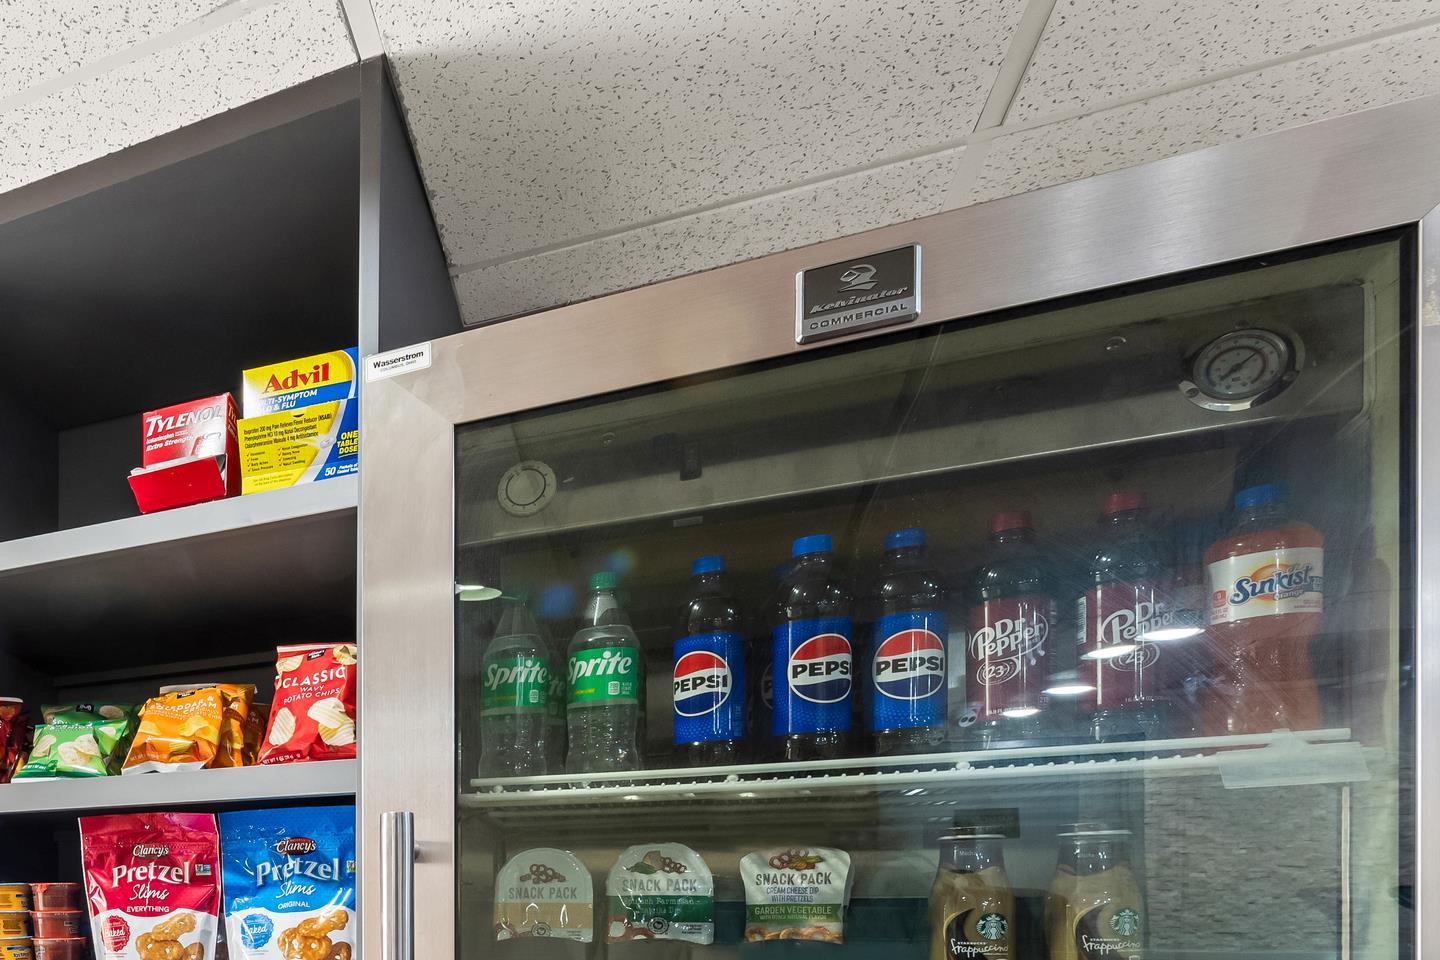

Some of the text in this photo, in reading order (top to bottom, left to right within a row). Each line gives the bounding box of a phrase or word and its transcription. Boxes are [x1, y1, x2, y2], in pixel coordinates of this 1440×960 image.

[809, 286, 908, 314] Kelvinator
[809, 303, 908, 330] COMMERCIAL
[373, 351, 424, 368] Wasserstrom
[263, 362, 329, 394] Advil
[262, 389, 318, 405] LTI-SYMPTOM
[281, 400, 296, 409] FLU
[145, 405, 223, 437] TYLENOL
[337, 438, 358, 448] TABLE
[341, 430, 358, 439] ONE
[145, 442, 163, 452] Extra
[339, 446, 358, 454] DOSE
[325, 466, 336, 476] 50
[1229, 564, 1312, 604] Sunkist
[994, 618, 1026, 635] Dr
[1111, 609, 1174, 645] Pepper
[976, 620, 1045, 661] Pepper
[875, 655, 944, 676] PEPSI
[1124, 650, 1144, 664] 23
[484, 658, 548, 691] Sprite
[568, 650, 632, 685] Sprite
[791, 659, 852, 680] PEPSI
[987, 665, 1005, 678] 23
[282, 666, 346, 689] CLASSIC
[673, 674, 728, 696] PEPSI
[283, 687, 340, 705] POTATO CHIPS
[300, 684, 325, 693] WAVY
[132, 843, 169, 858] Clancy's
[276, 839, 317, 853] Clancy's
[111, 861, 190, 888] Pretzel
[256, 857, 339, 886] Pretzel
[755, 872, 832, 886] SNACK PACK
[129, 883, 170, 901] Slims
[275, 880, 316, 899] Slims
[508, 887, 577, 900] SNACK PACK
[622, 878, 697, 892] SNACK PACK
[766, 886, 786, 895] CREAM
[786, 886, 809, 895] CHEESE
[277, 900, 311, 910] ORIGINAL
[786, 894, 814, 902] PRETZELS
[126, 905, 170, 913] EVERYTHING
[754, 906, 832, 915] GARDEN VEGETABLE
[950, 938, 1008, 958] frappuccino
[1082, 934, 1141, 956] frappuccino
